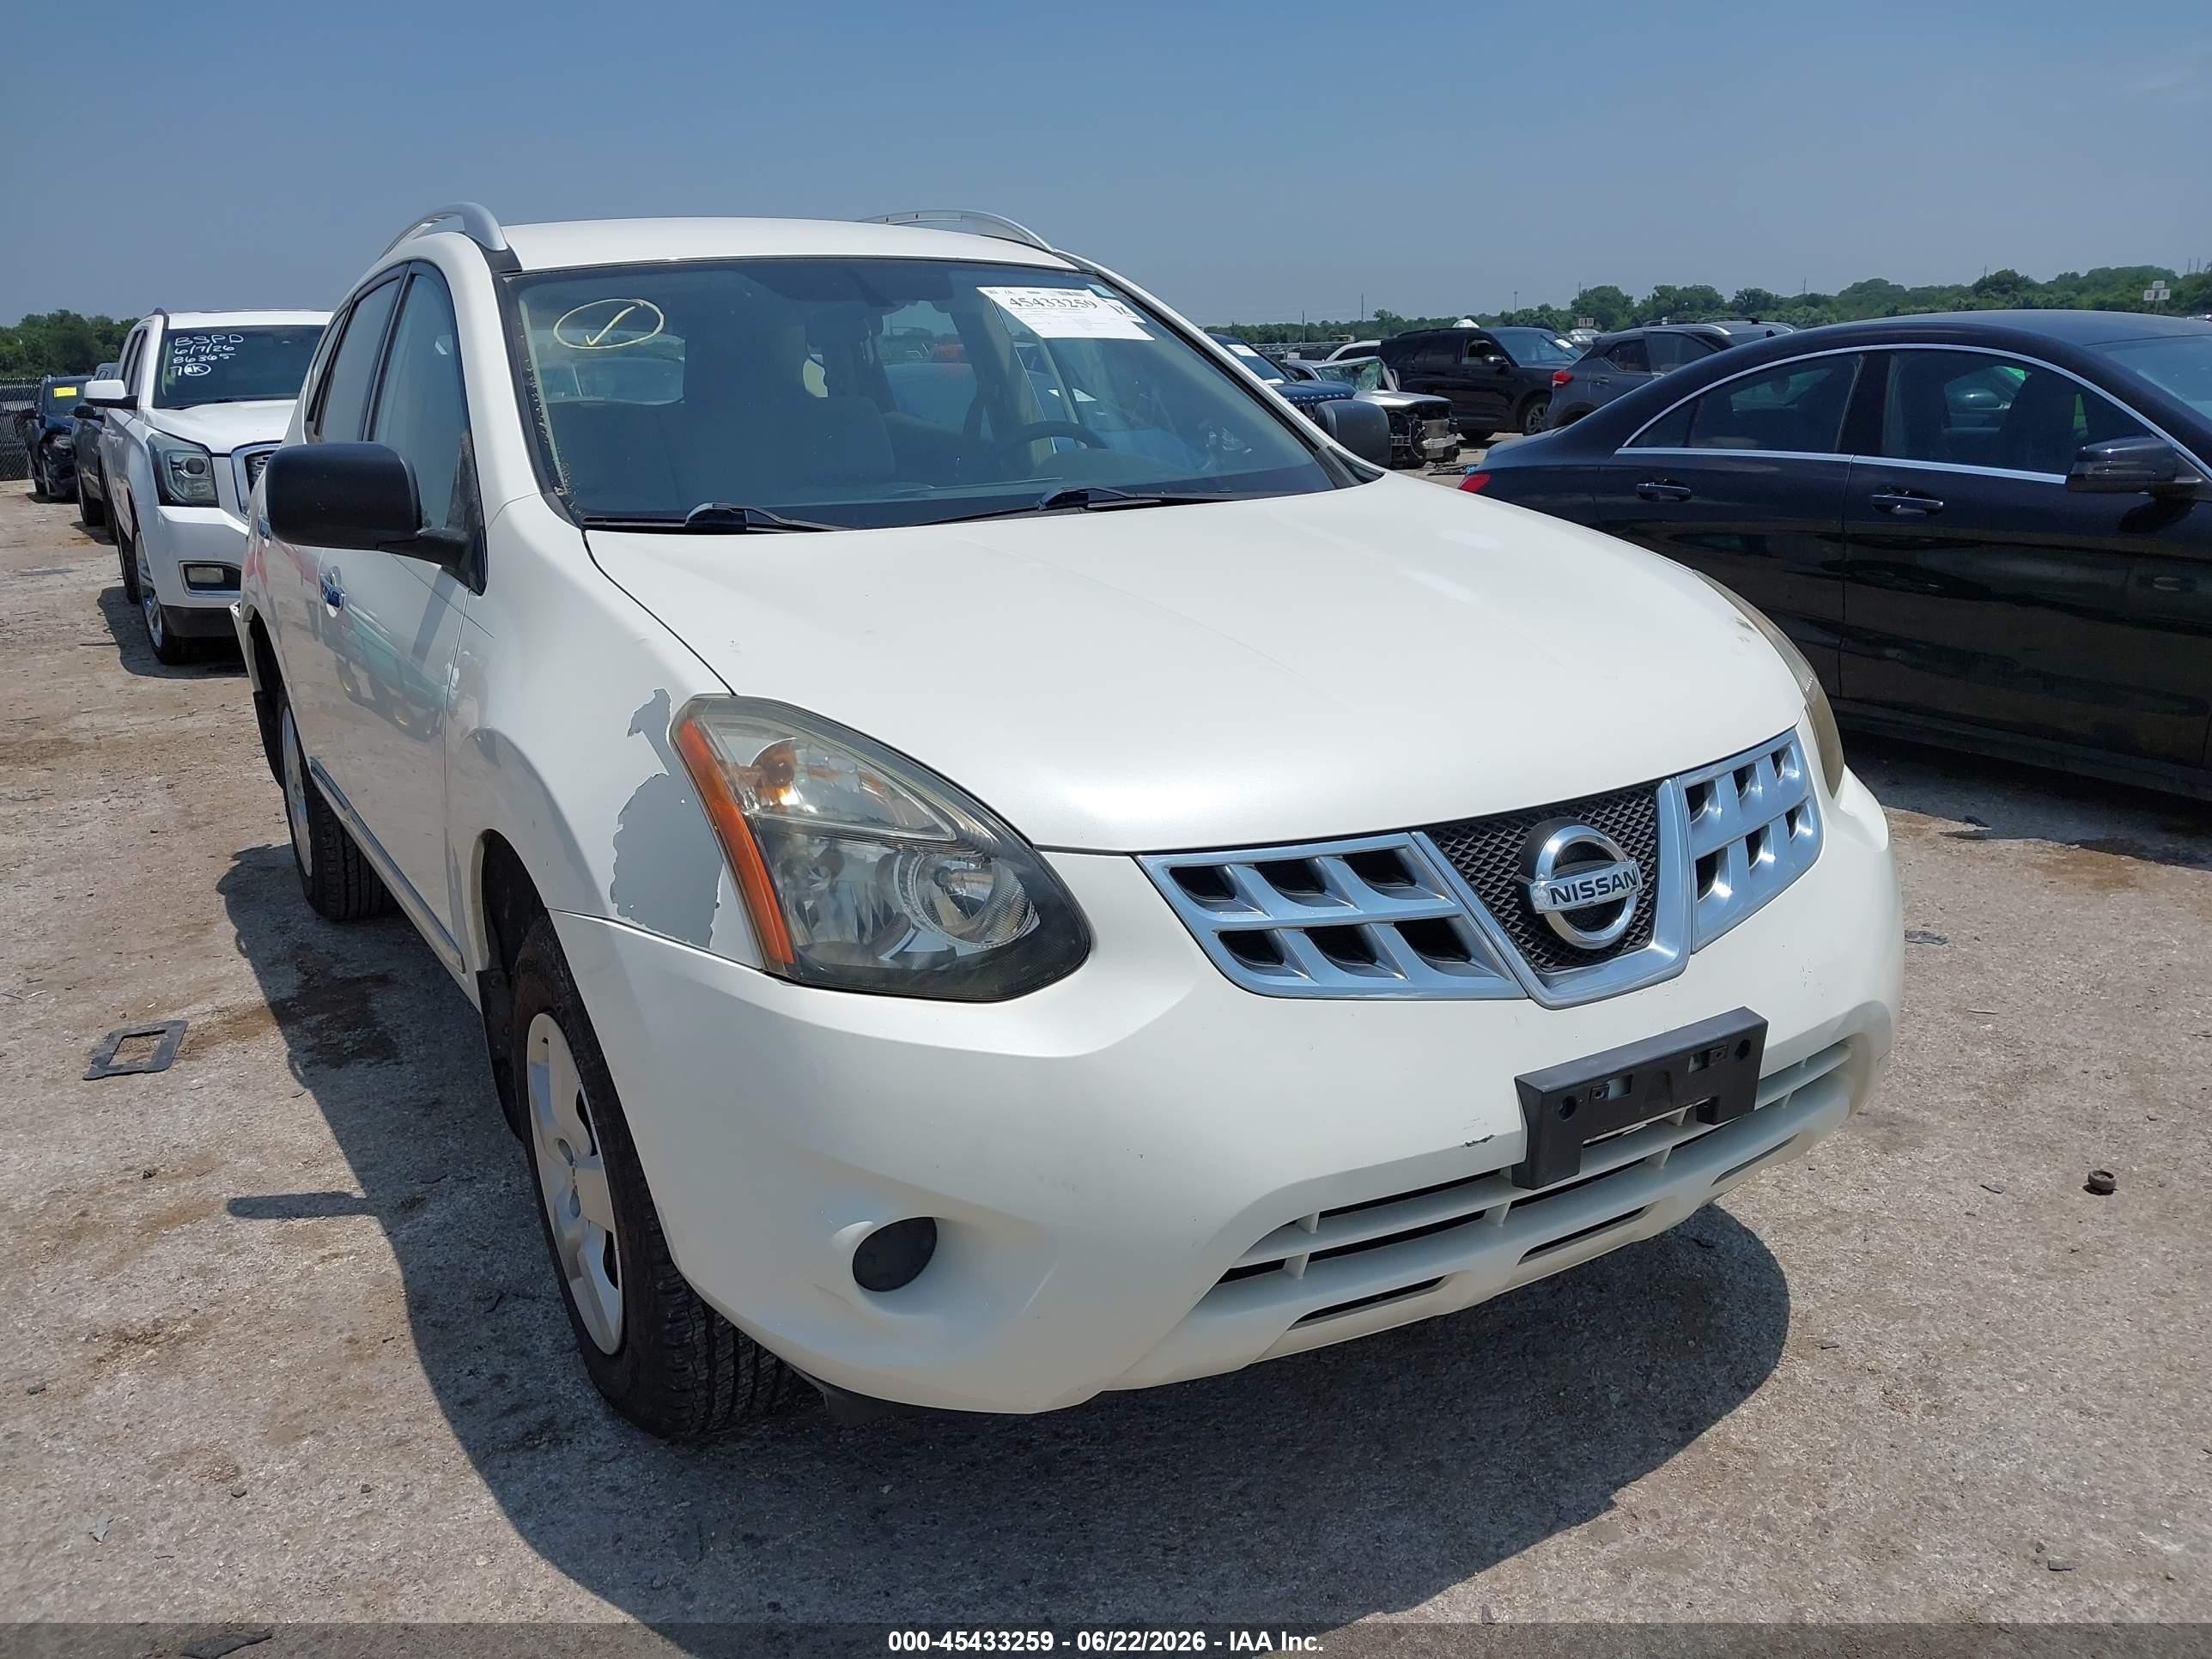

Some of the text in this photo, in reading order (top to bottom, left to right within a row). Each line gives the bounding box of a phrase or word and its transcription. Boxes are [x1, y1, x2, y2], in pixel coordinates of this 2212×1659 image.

[1010, 296, 1098, 308] 45433259
[174, 343, 235, 355] 6/7/26
[173, 353, 236, 364] 86365
[1550, 868, 1638, 905] NISSAN
